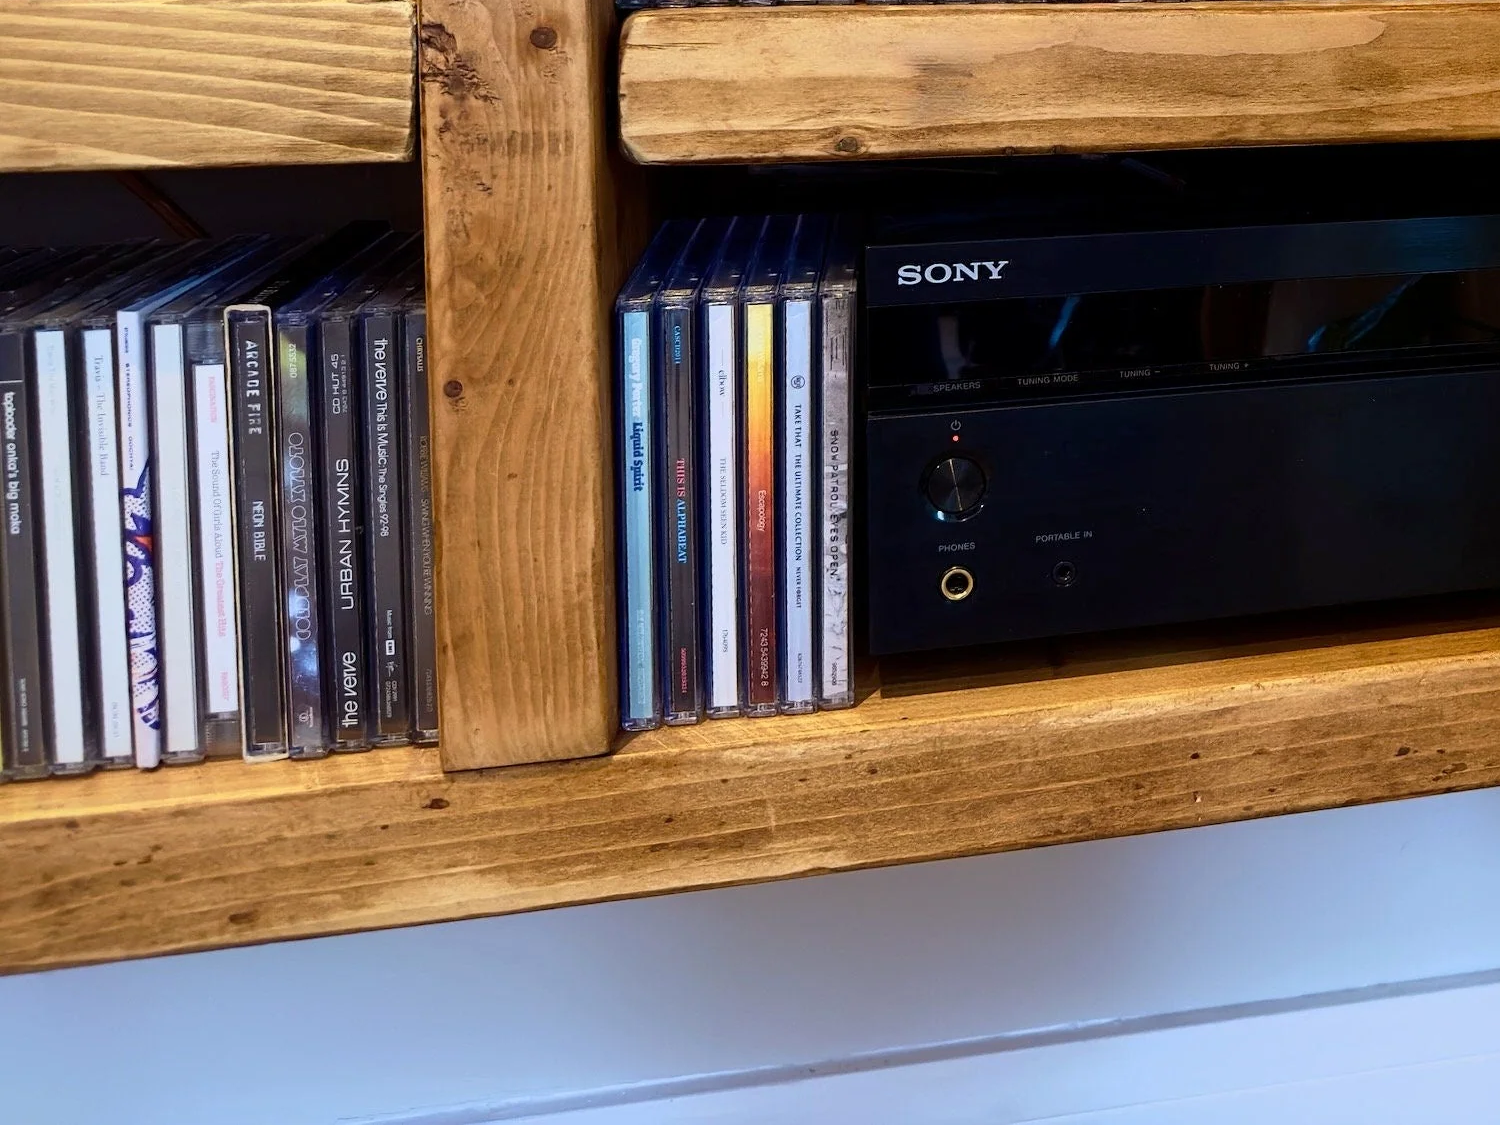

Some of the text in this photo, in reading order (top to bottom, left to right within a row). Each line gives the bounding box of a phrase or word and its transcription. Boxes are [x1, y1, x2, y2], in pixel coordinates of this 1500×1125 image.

[896, 259, 1010, 287] SONY
[245, 339, 260, 397] ARCADE
[373, 338, 388, 431] the verve This Is
[631, 422, 645, 491] Liquid Spirit
[794, 404, 802, 561] TAKE THAT THE ULTIMATE COLLECTION
[252, 500, 266, 561] NEON BIBLE
[335, 459, 354, 610] URBAN HYMNS
[676, 458, 687, 564] THIS IS ALPHABEAT
[756, 489, 767, 532] Escapology
[938, 542, 976, 553] PHONES
[344, 652, 359, 728] the verve
